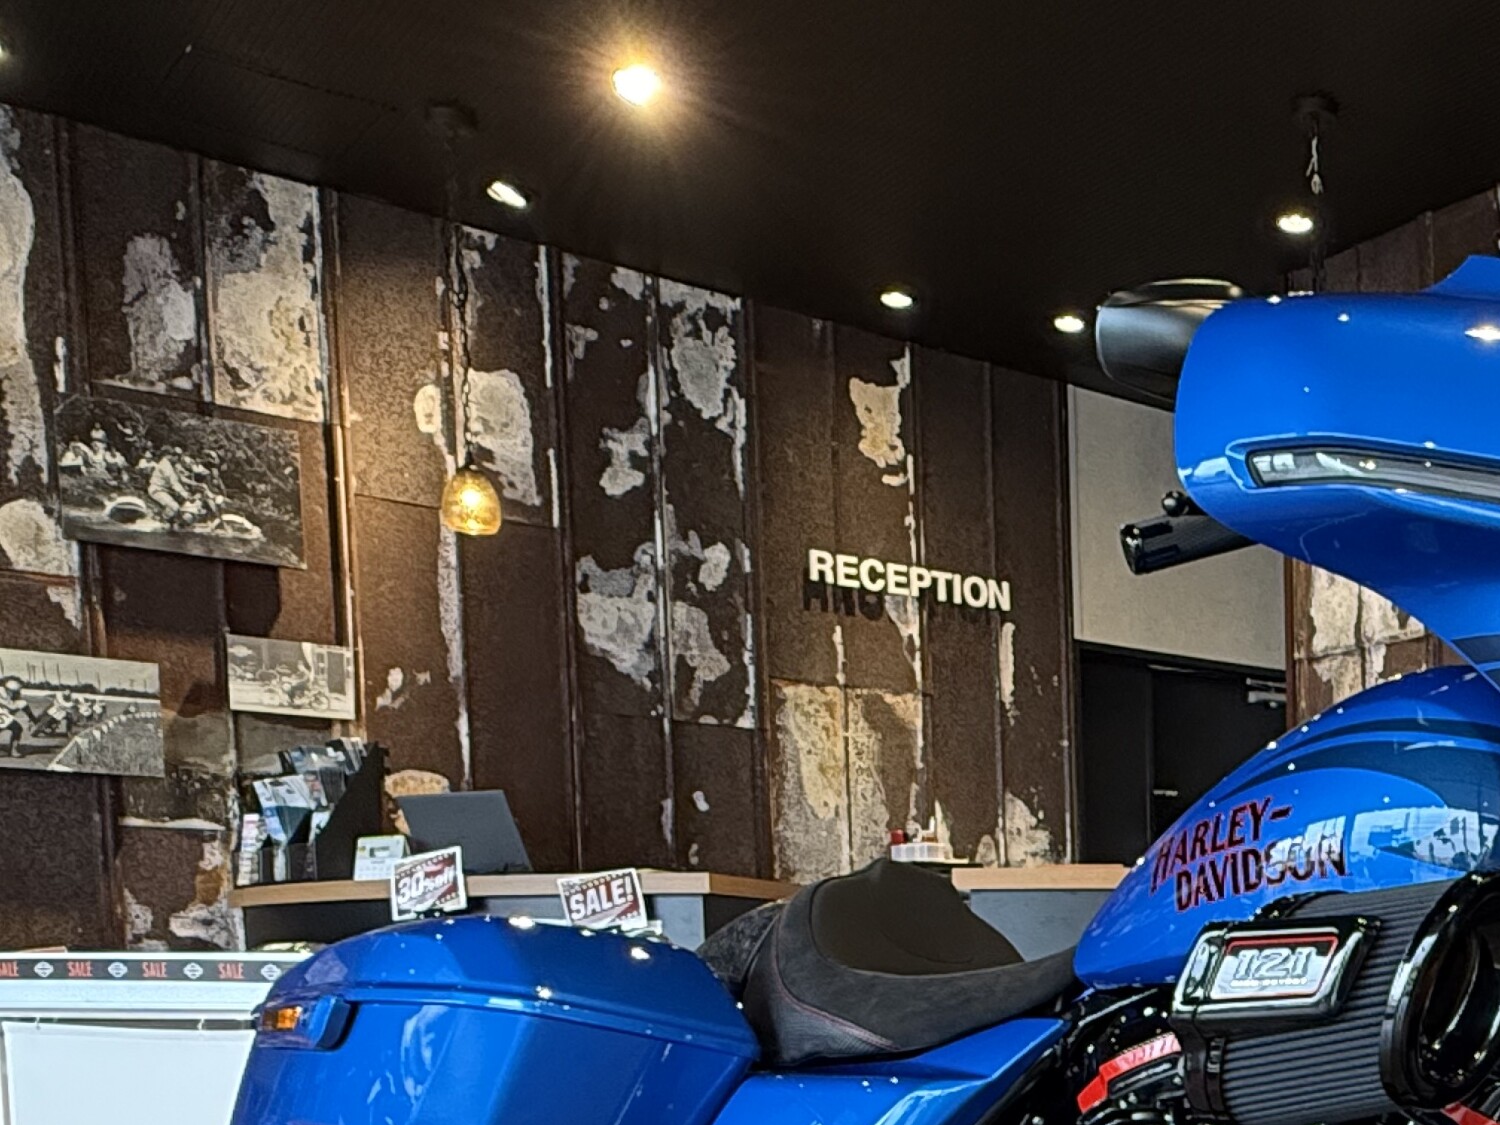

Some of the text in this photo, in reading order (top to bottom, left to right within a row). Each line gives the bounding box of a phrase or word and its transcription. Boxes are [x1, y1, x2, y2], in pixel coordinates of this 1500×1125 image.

[808, 549, 1011, 612] RECEPTION
[1150, 797, 1293, 895] HARLEY-
[569, 875, 634, 921] SALE!
[1175, 836, 1348, 914] DAVIDSON
[0, 960, 19, 977] ALE
[66, 960, 94, 977] SALE
[142, 961, 167, 978] SALE
[217, 962, 245, 980] SALE
[1232, 946, 1318, 981] 121
